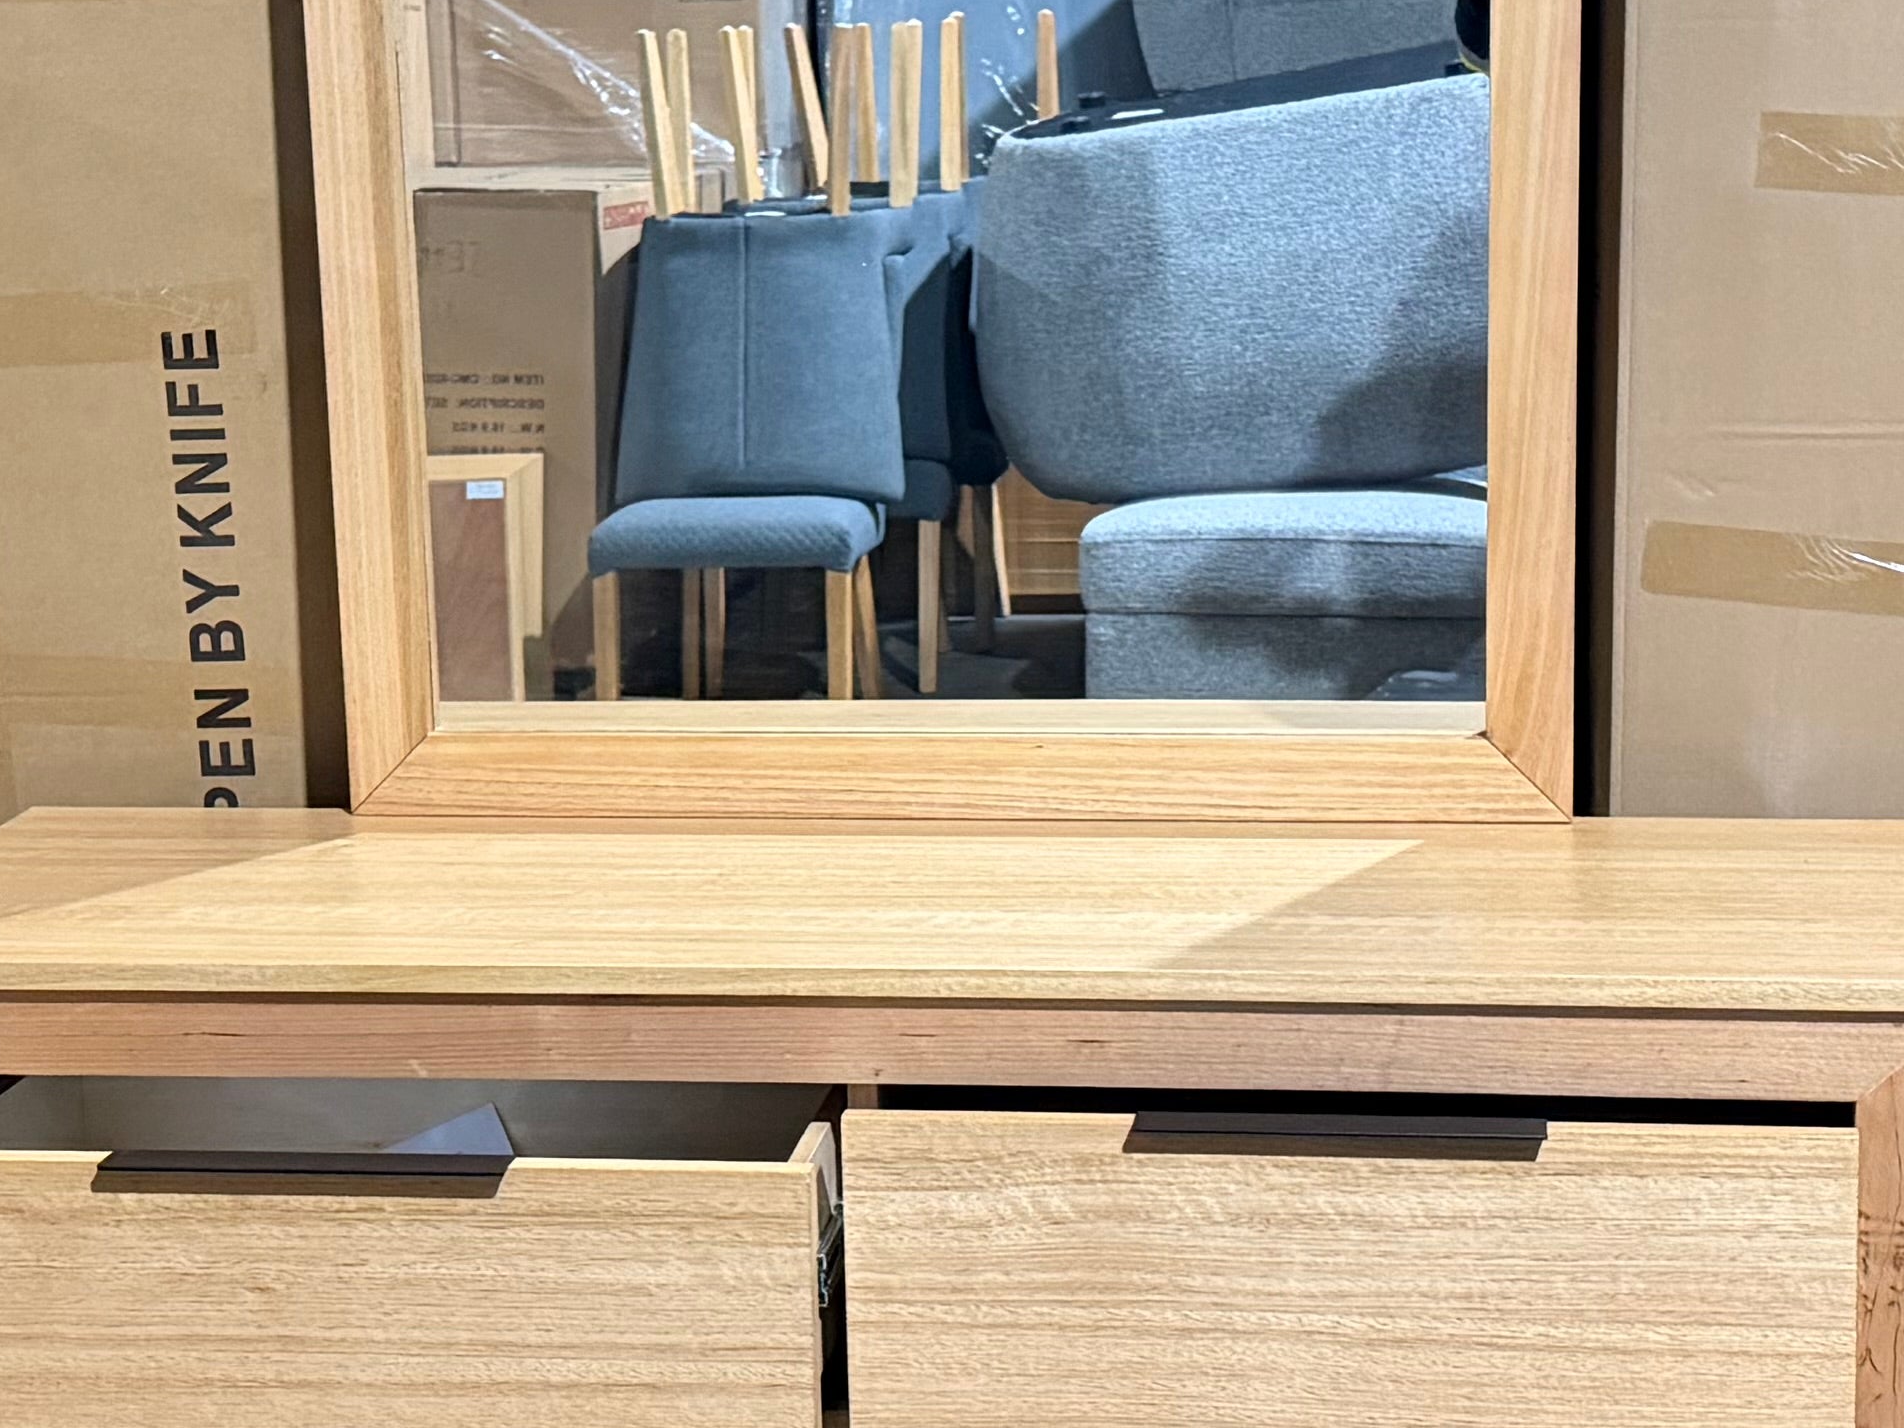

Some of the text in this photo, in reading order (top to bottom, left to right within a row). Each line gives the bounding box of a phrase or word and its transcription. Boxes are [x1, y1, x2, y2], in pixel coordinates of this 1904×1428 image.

[161, 329, 256, 808] PEN BY KNIFE
